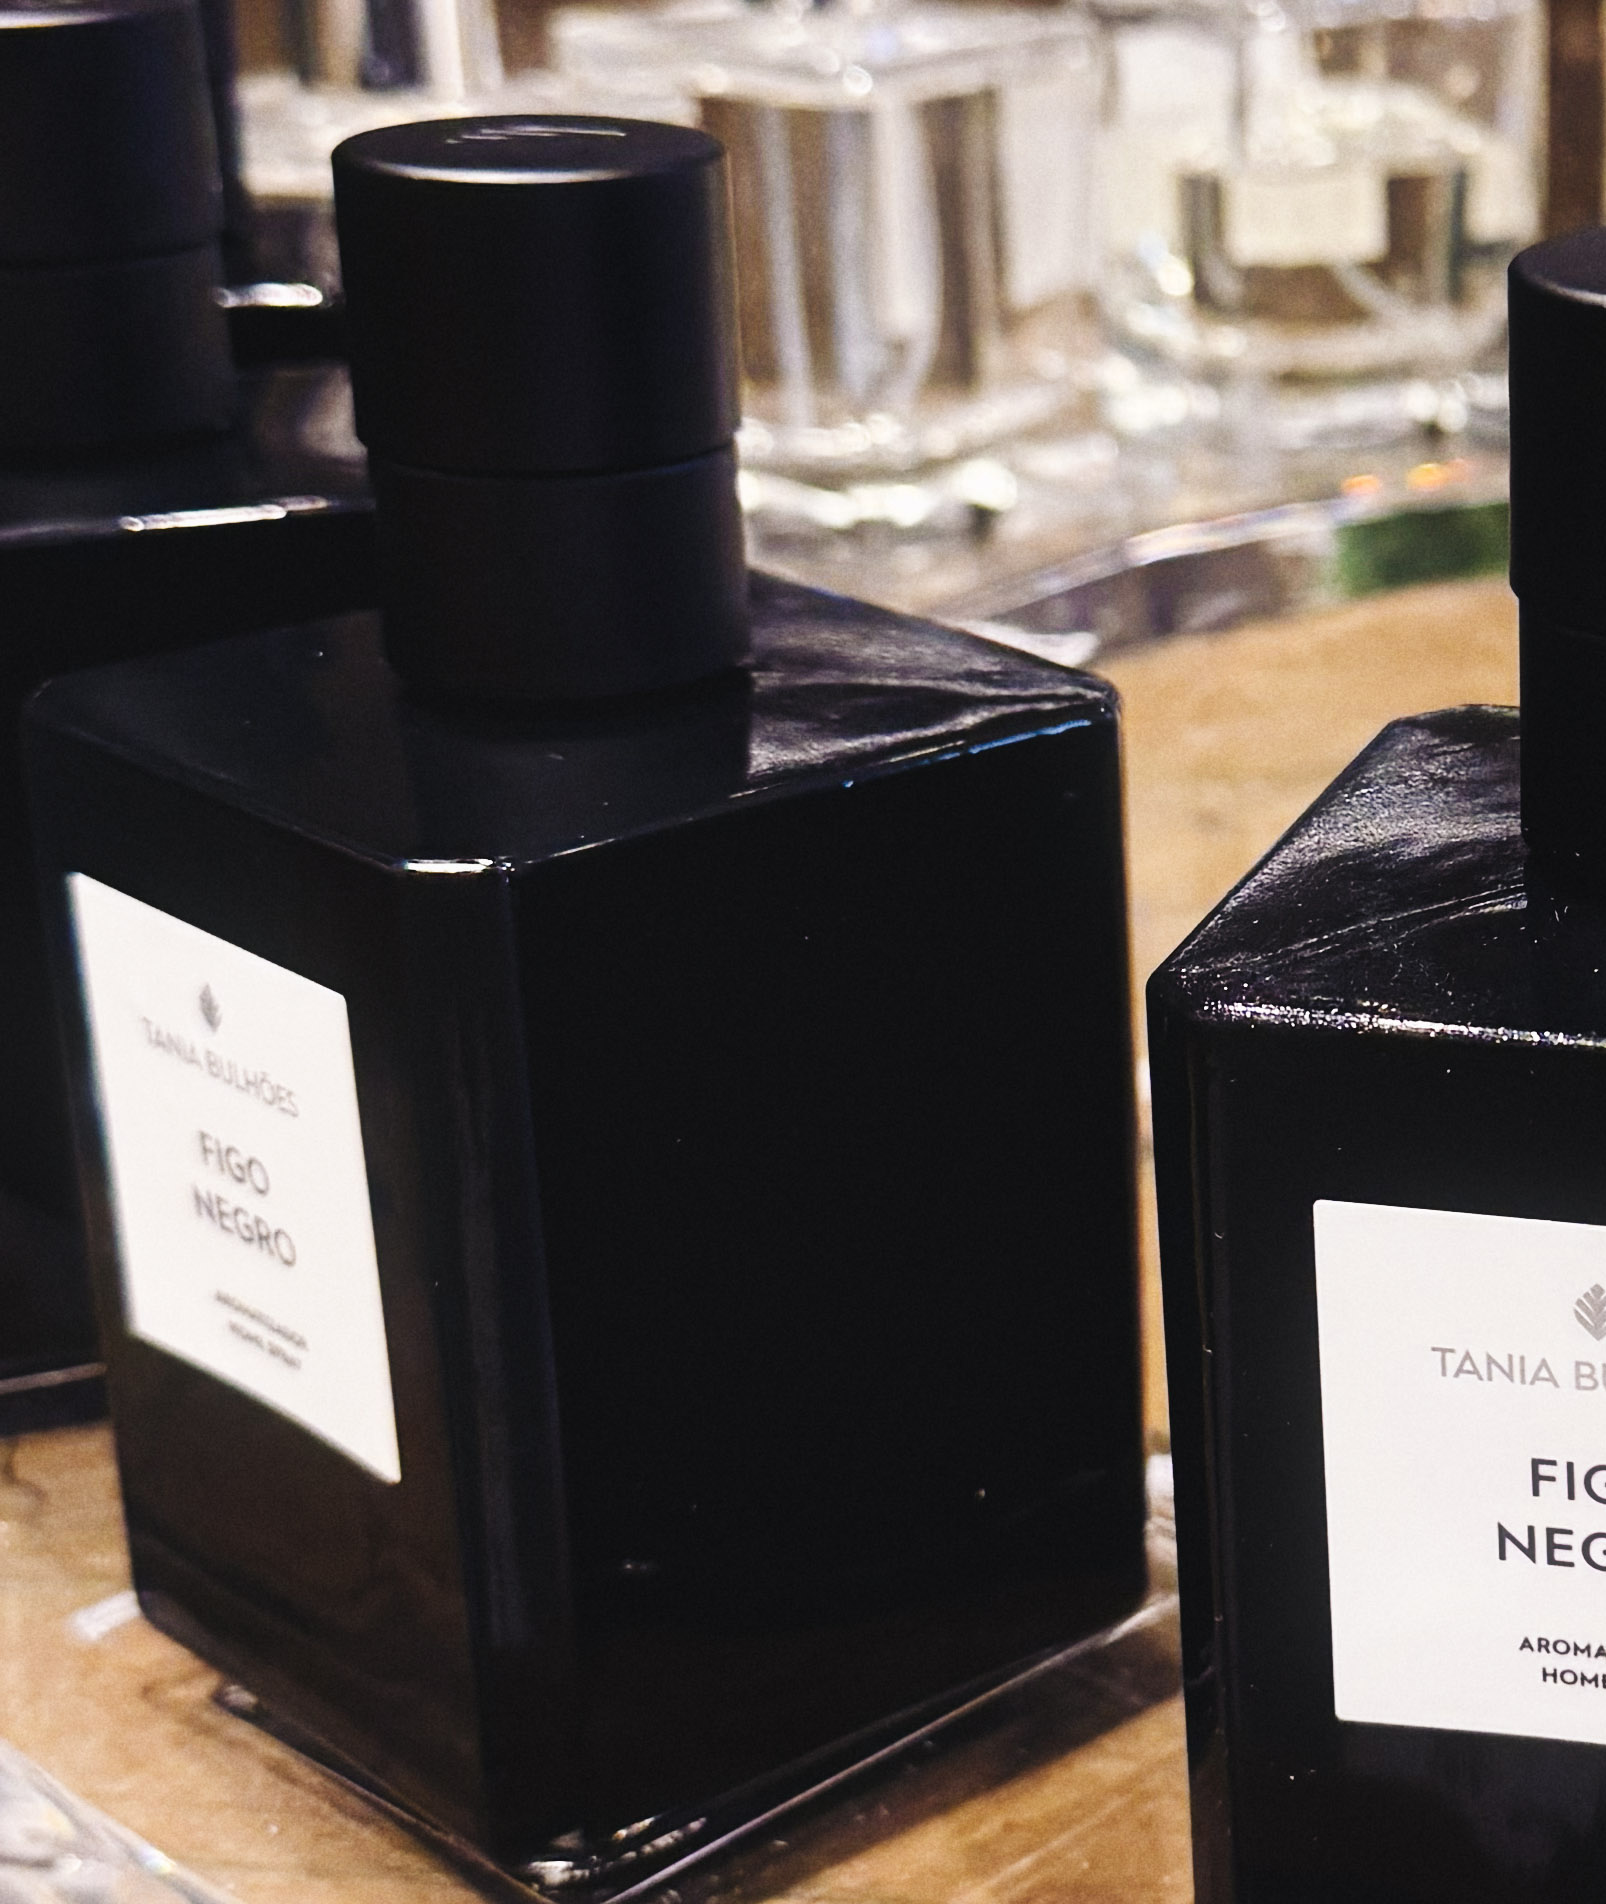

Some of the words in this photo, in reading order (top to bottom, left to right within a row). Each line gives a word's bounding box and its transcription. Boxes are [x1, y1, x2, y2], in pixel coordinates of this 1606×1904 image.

[141, 1015, 201, 1070] TANIA
[198, 1129, 271, 1197] FIGO
[193, 1187, 298, 1269] NEGRO
[1430, 1346, 1560, 1389] TANIA
